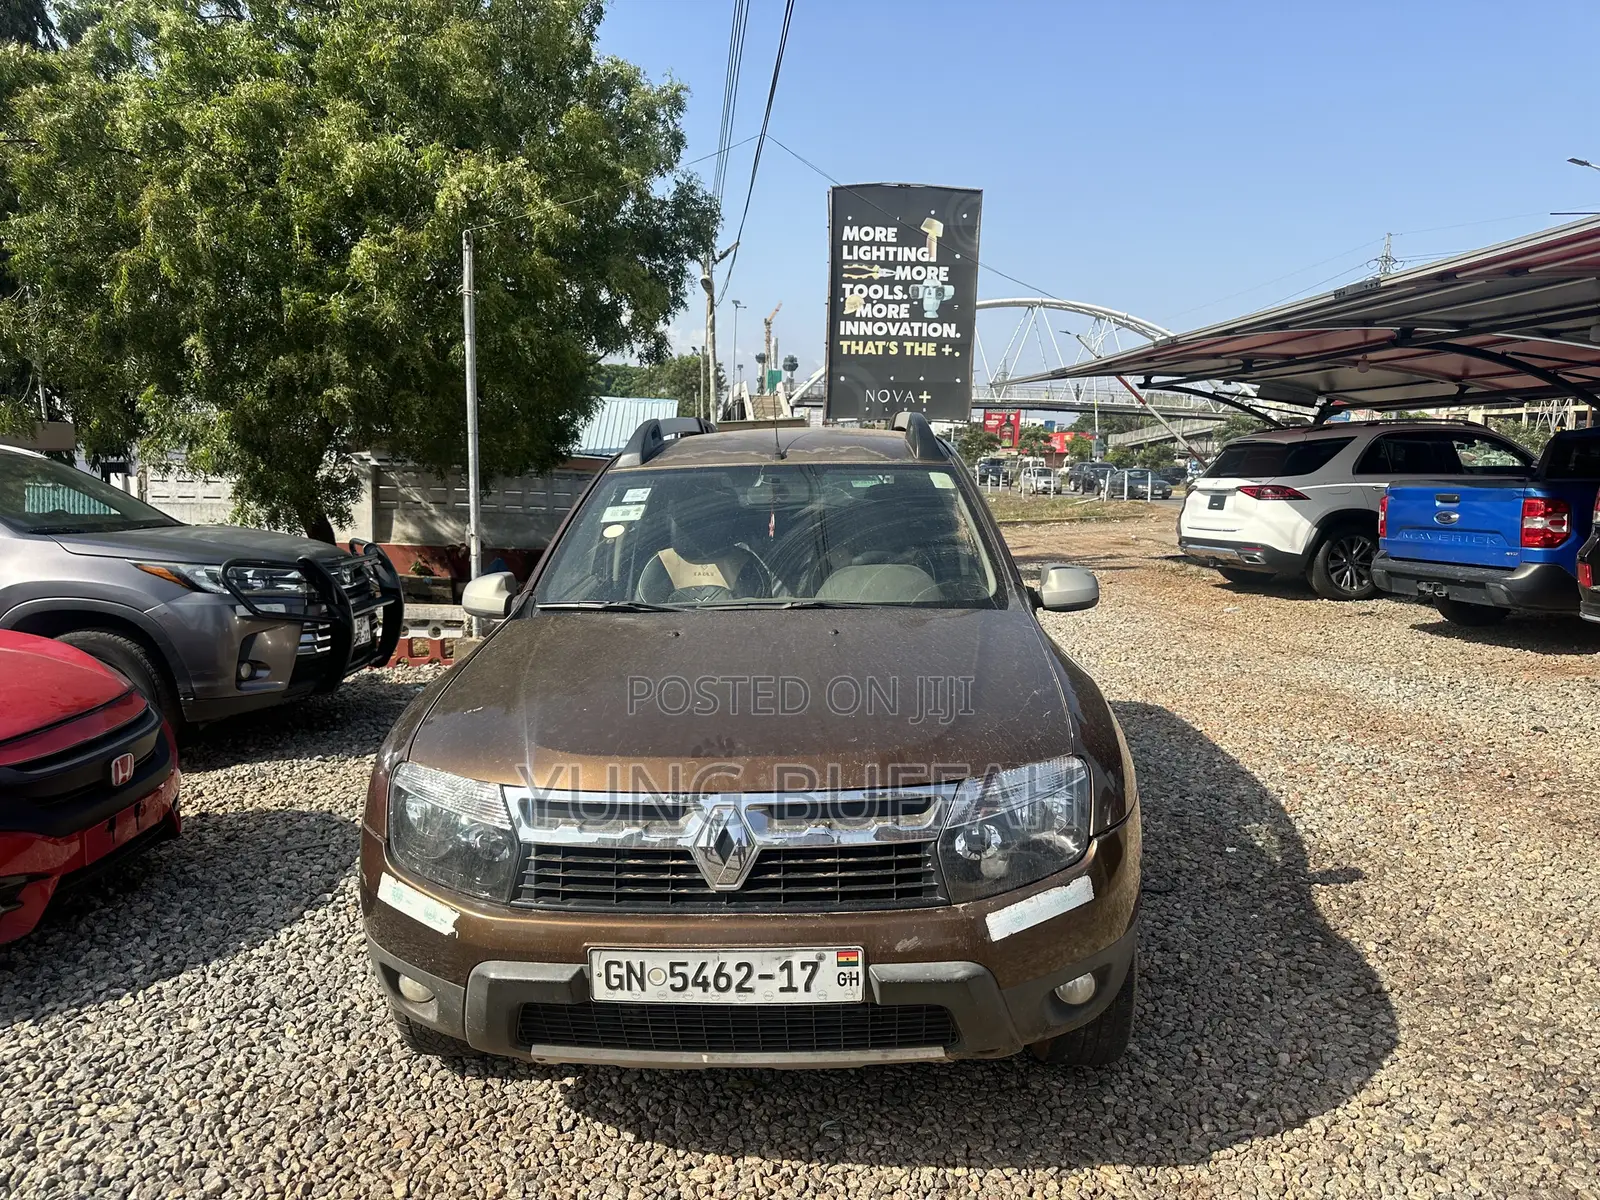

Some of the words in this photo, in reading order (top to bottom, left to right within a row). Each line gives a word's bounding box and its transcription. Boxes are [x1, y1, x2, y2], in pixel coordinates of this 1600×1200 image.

[842, 225, 898, 243] MORE
[894, 265, 950, 281] MORE
[841, 283, 908, 300] TOOLS.
[855, 303, 910, 318] MORE
[839, 320, 961, 338] INNOVATION.
[839, 340, 899, 355] THAT'S
[903, 341, 937, 356] THE
[1402, 532, 1498, 545] MAVERICK
[604, 960, 646, 992] GN
[669, 960, 819, 993] 5462-17
[837, 971, 860, 987] GH
